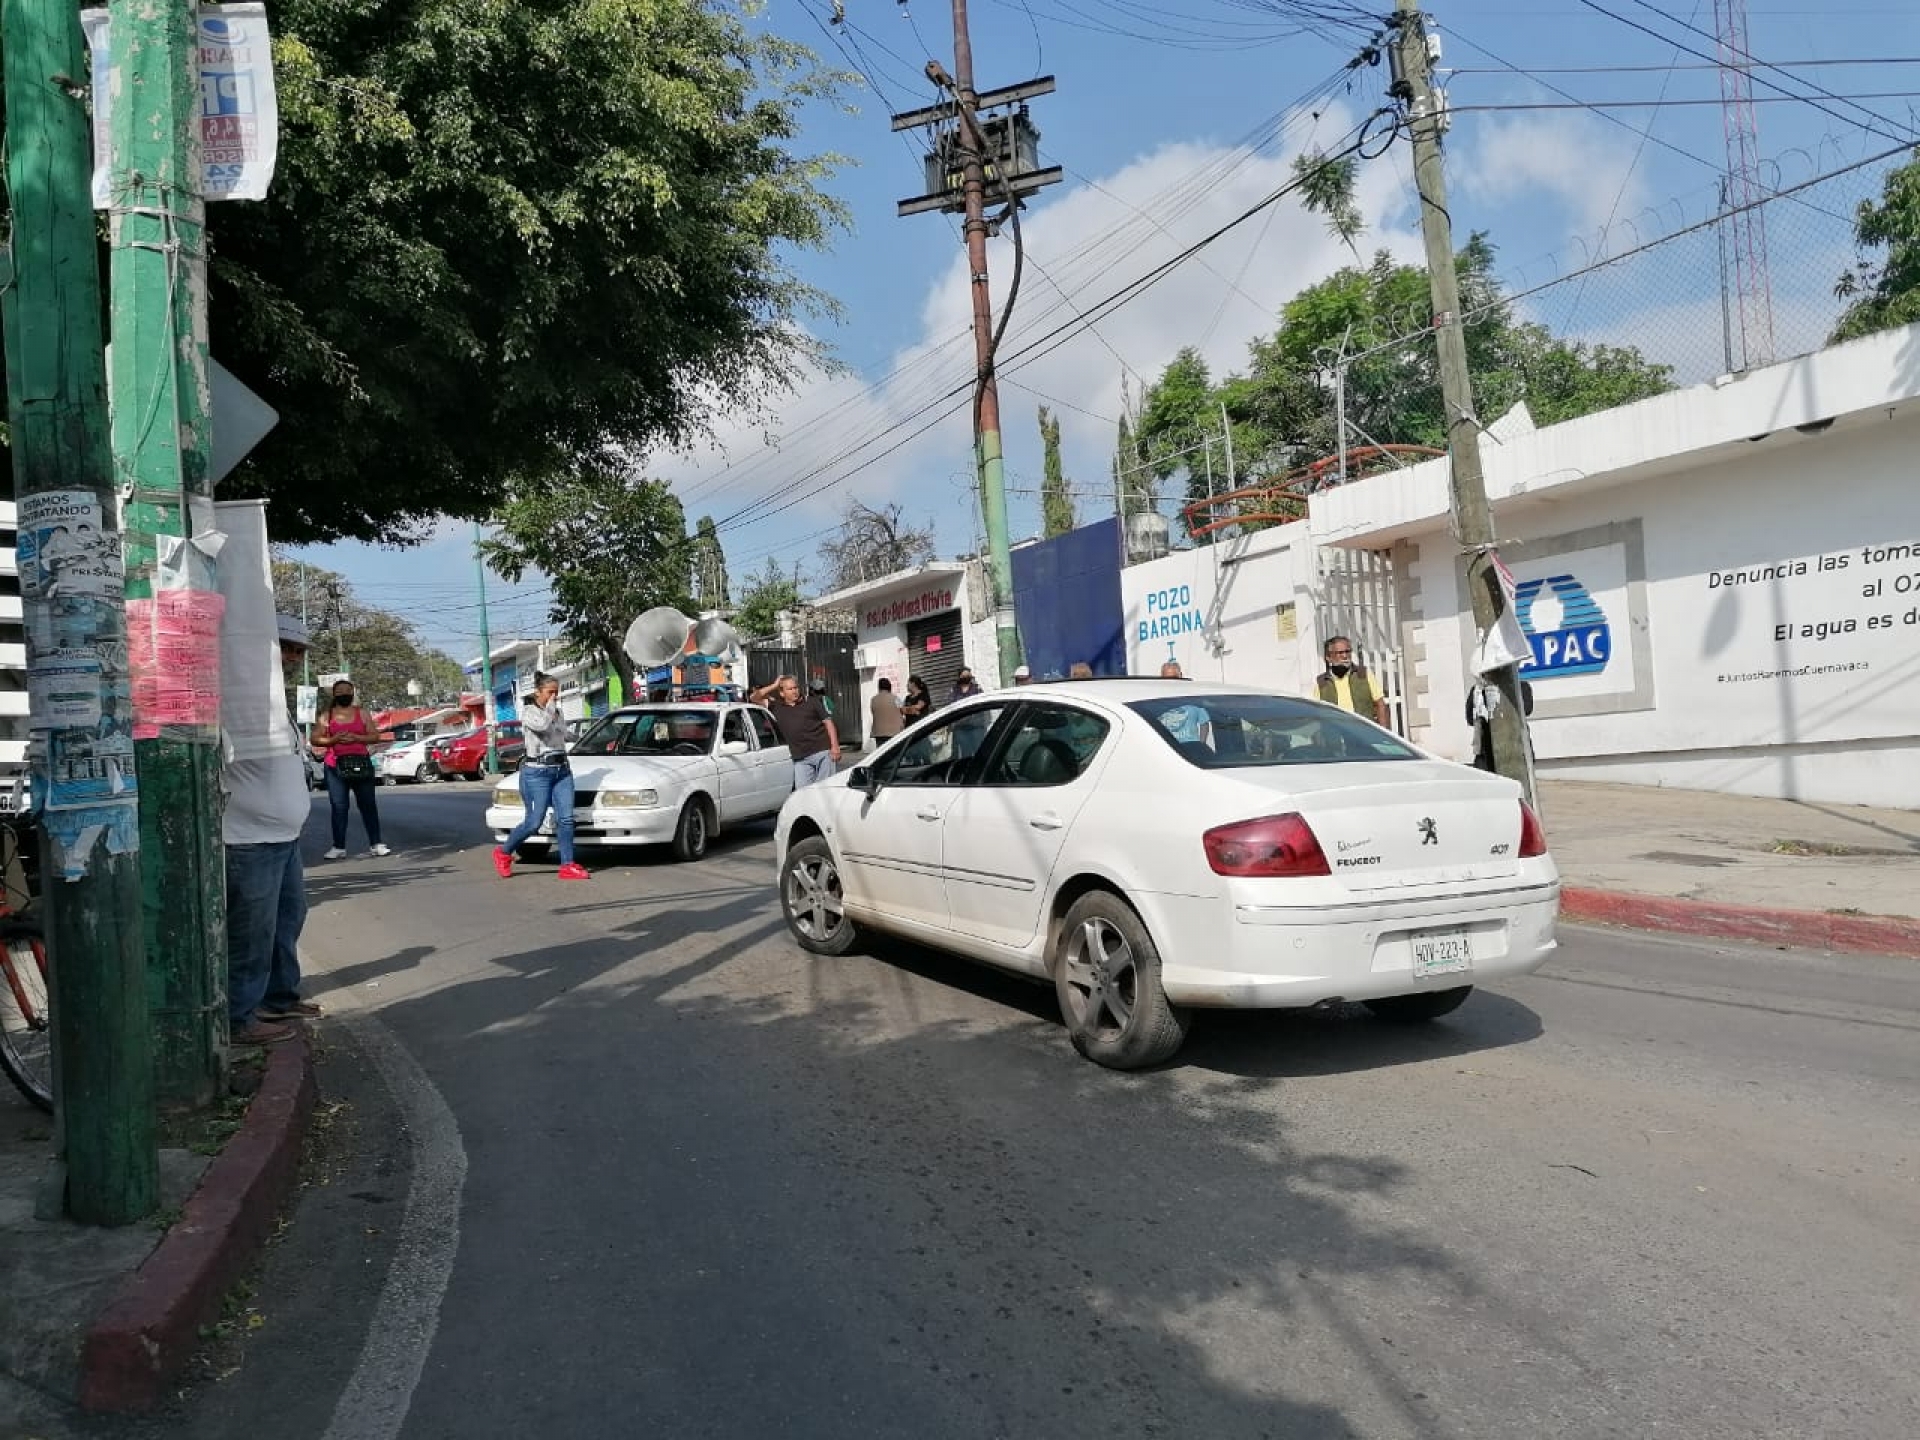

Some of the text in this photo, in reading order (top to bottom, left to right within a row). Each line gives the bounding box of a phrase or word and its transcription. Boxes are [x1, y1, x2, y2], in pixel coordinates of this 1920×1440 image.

[23, 494, 70, 512] ESTAMOS
[1709, 560, 1807, 589] Denuncia
[1817, 554, 1850, 572] las
[1146, 584, 1191, 613] POZO
[1862, 578, 1882, 597] al
[1139, 609, 1204, 642] BARONA
[1775, 623, 1793, 641] El
[1801, 618, 1857, 641] agua
[1866, 613, 1893, 629] es
[1489, 843, 1510, 855] 407
[1337, 855, 1382, 867] PEUGEOT
